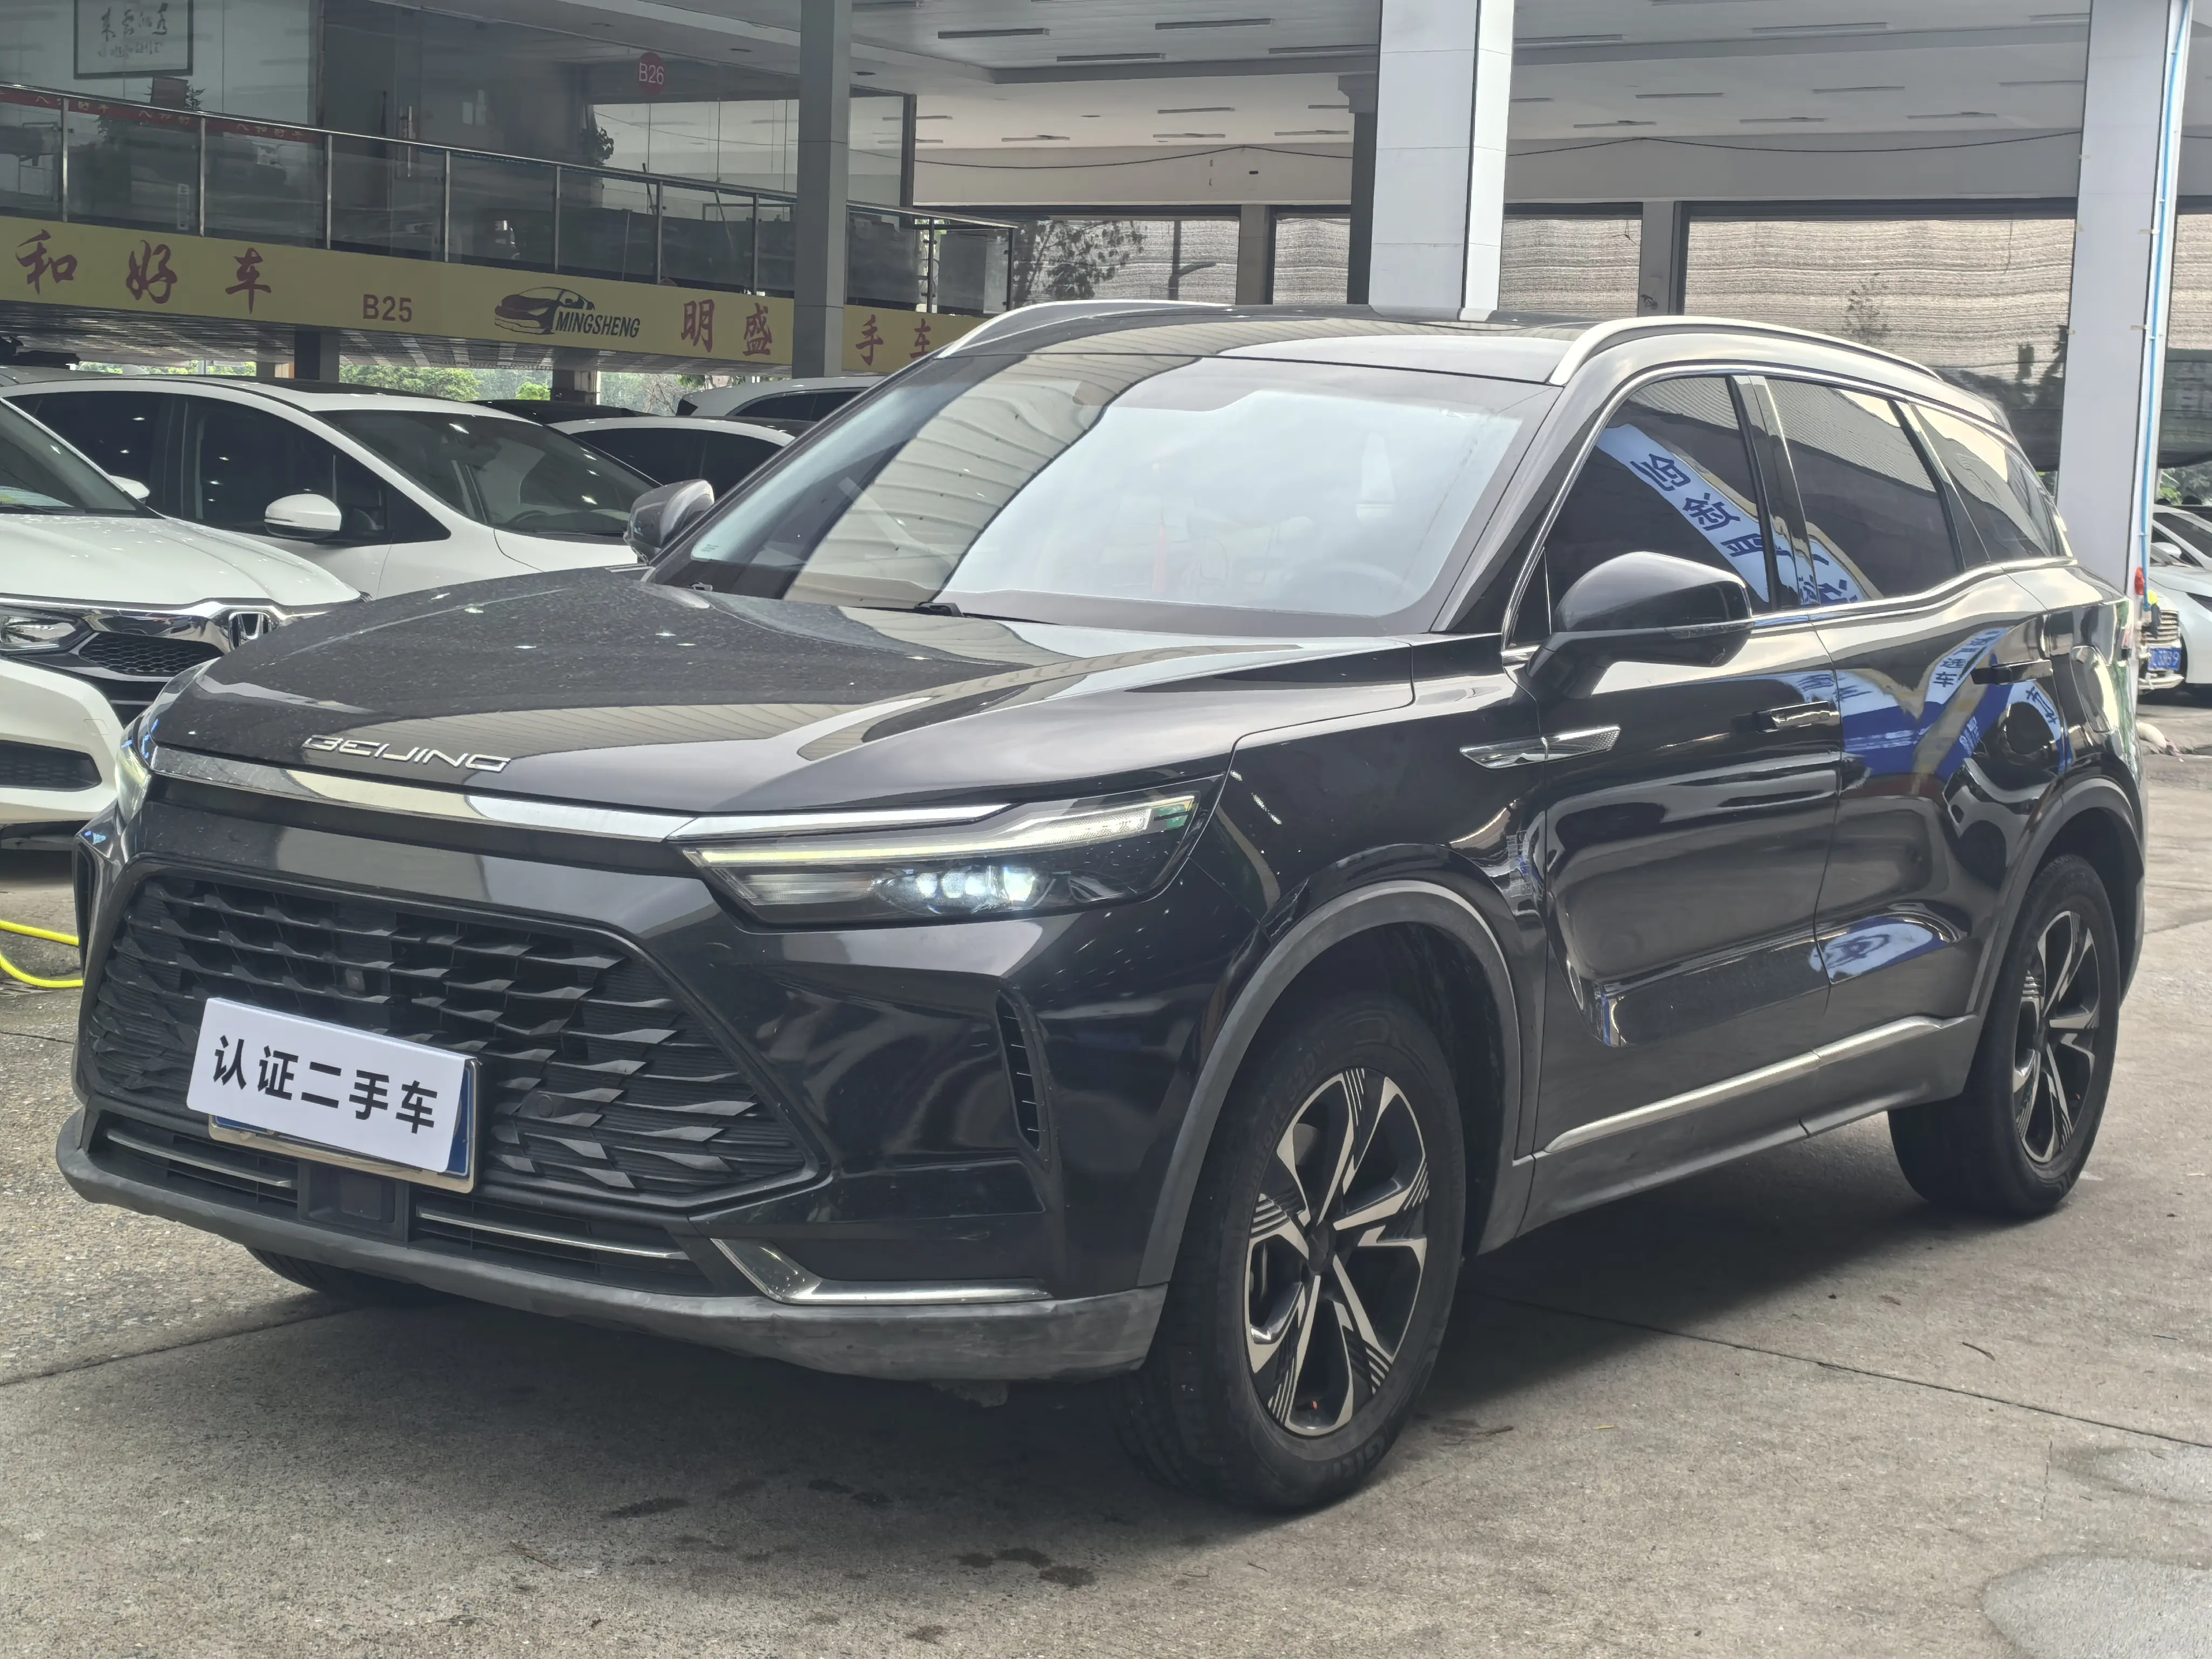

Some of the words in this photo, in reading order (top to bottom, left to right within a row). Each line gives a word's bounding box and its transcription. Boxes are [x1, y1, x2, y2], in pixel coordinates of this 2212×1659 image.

[639, 62, 664, 85] B26
[363, 294, 413, 322] B25
[555, 311, 641, 338] MINGSHENG
[301, 734, 511, 773] BEIJING
[213, 1035, 438, 1134] 认证二手车
